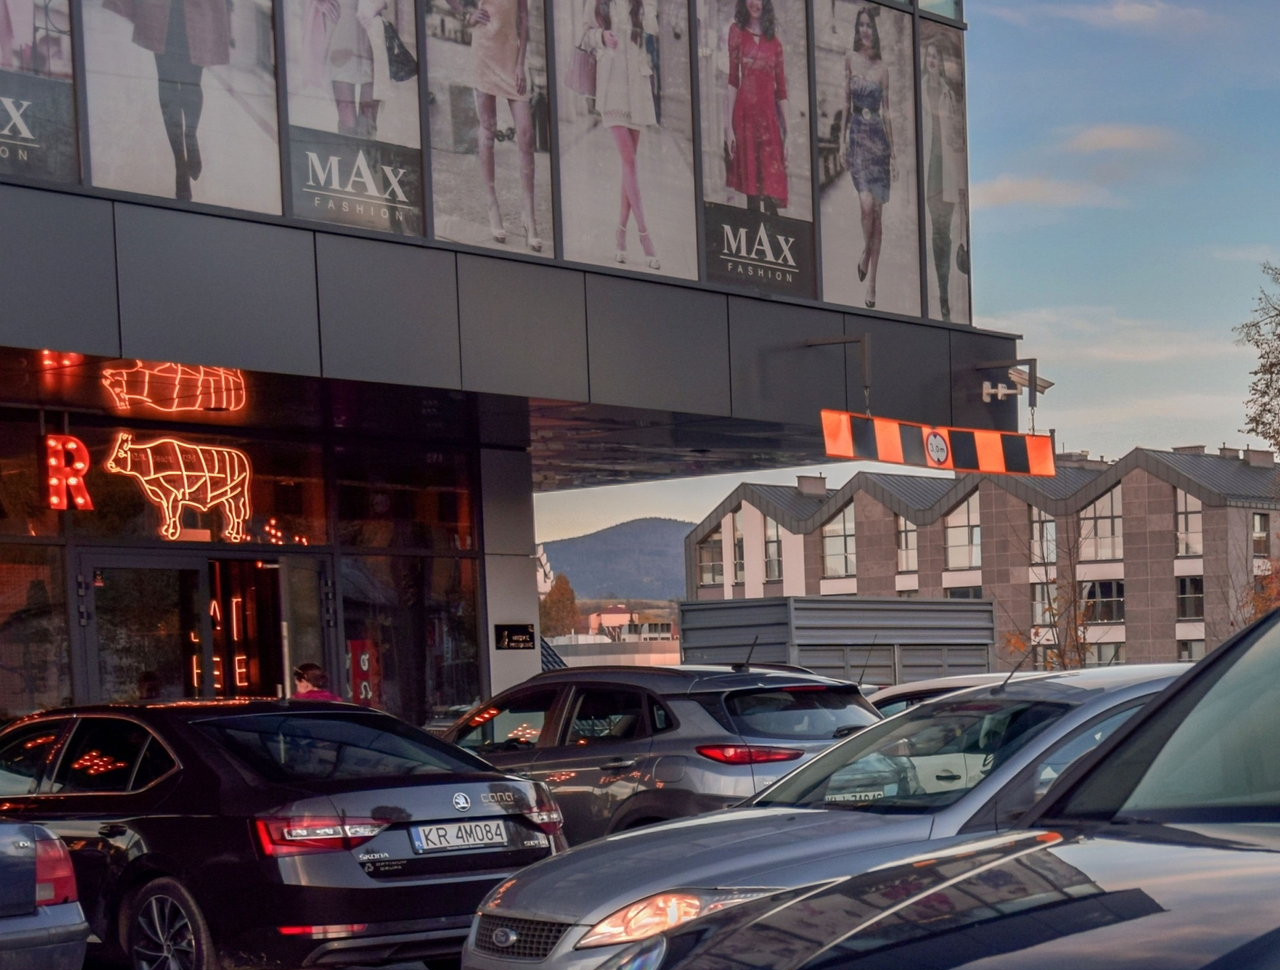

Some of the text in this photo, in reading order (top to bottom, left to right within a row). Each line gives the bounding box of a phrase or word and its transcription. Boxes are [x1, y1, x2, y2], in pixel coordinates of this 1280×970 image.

[305, 149, 409, 203] MAX
[314, 197, 403, 221] FASHION
[721, 222, 797, 266] MAX
[727, 262, 793, 282] FASHION
[47, 434, 94, 510] R
[423, 823, 505, 847] KR 4M084
